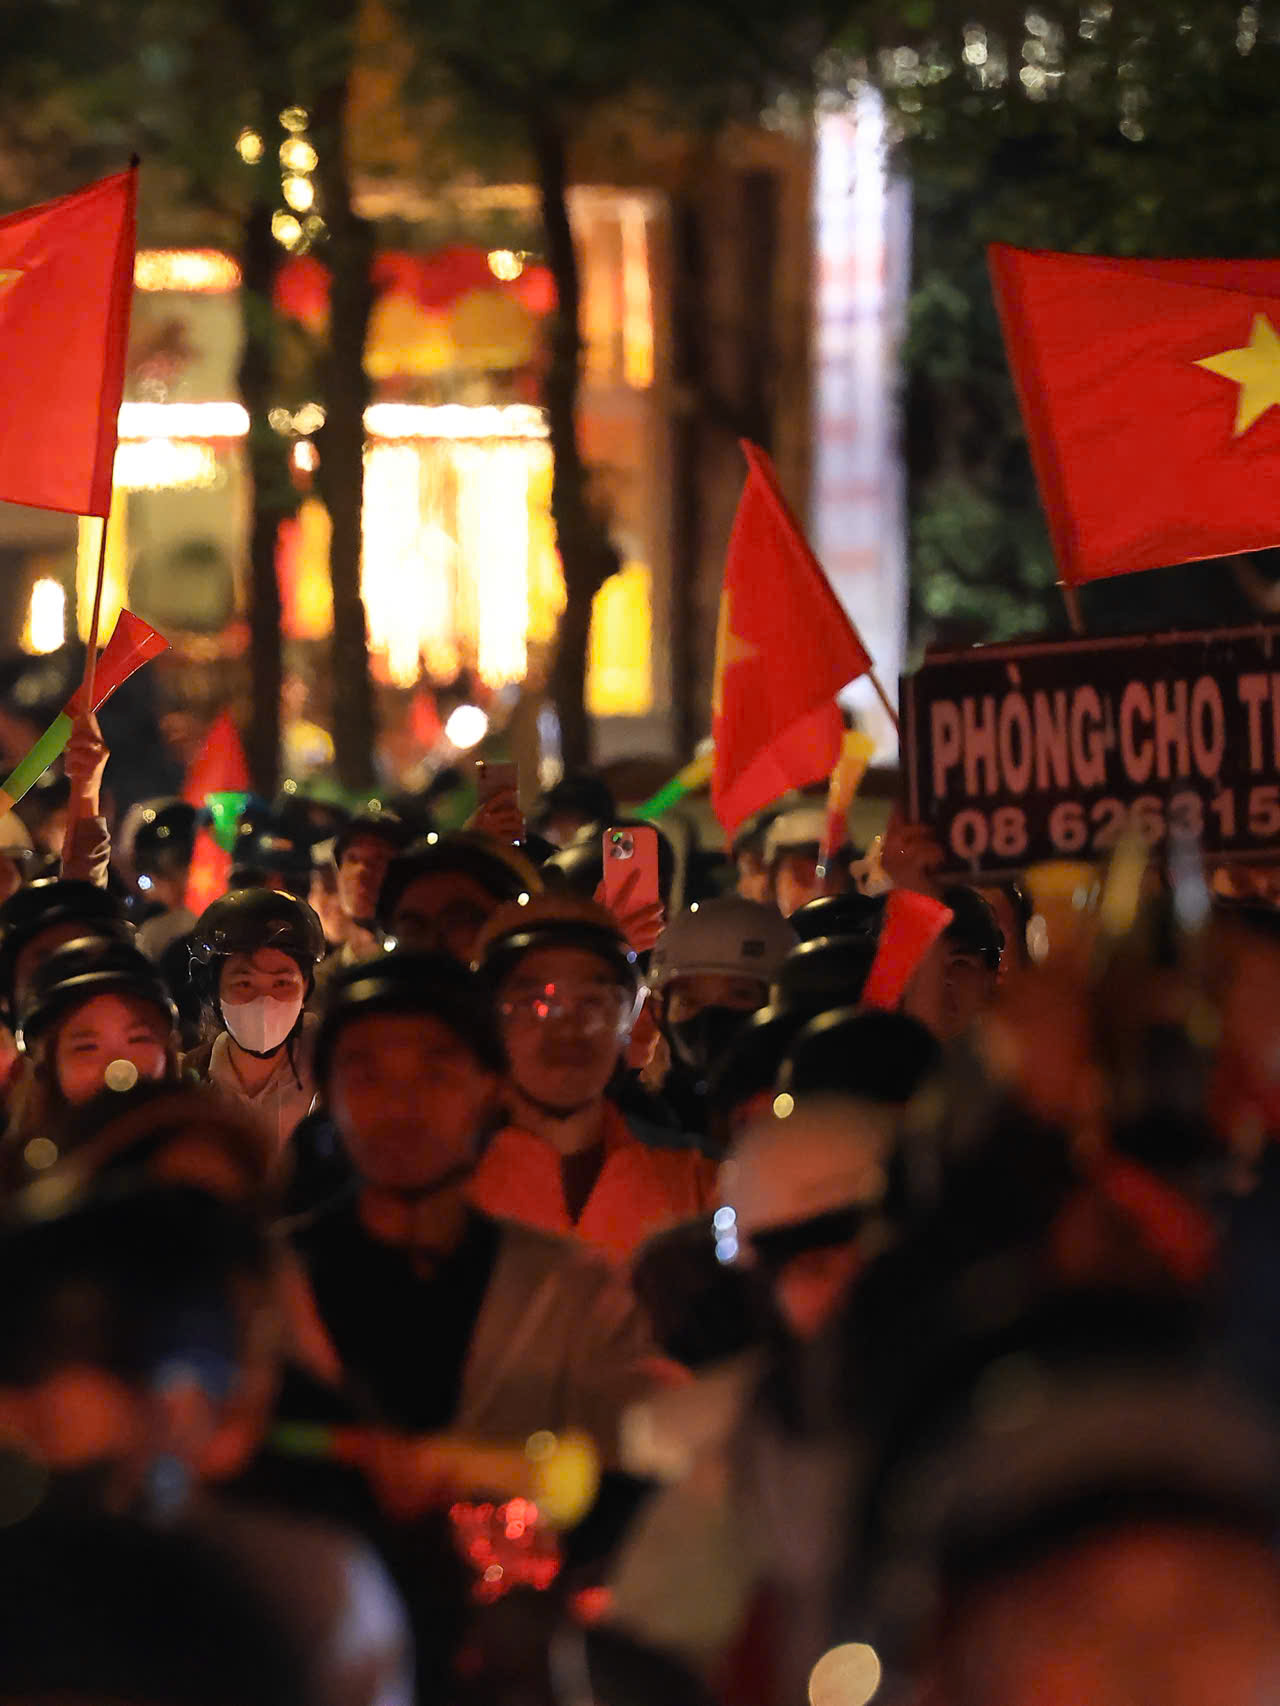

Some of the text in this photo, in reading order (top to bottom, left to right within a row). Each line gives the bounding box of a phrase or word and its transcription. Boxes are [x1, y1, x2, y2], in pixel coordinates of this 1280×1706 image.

[931, 662, 1280, 797] PHÒNG CHO T
[951, 806, 1028, 859] 08
